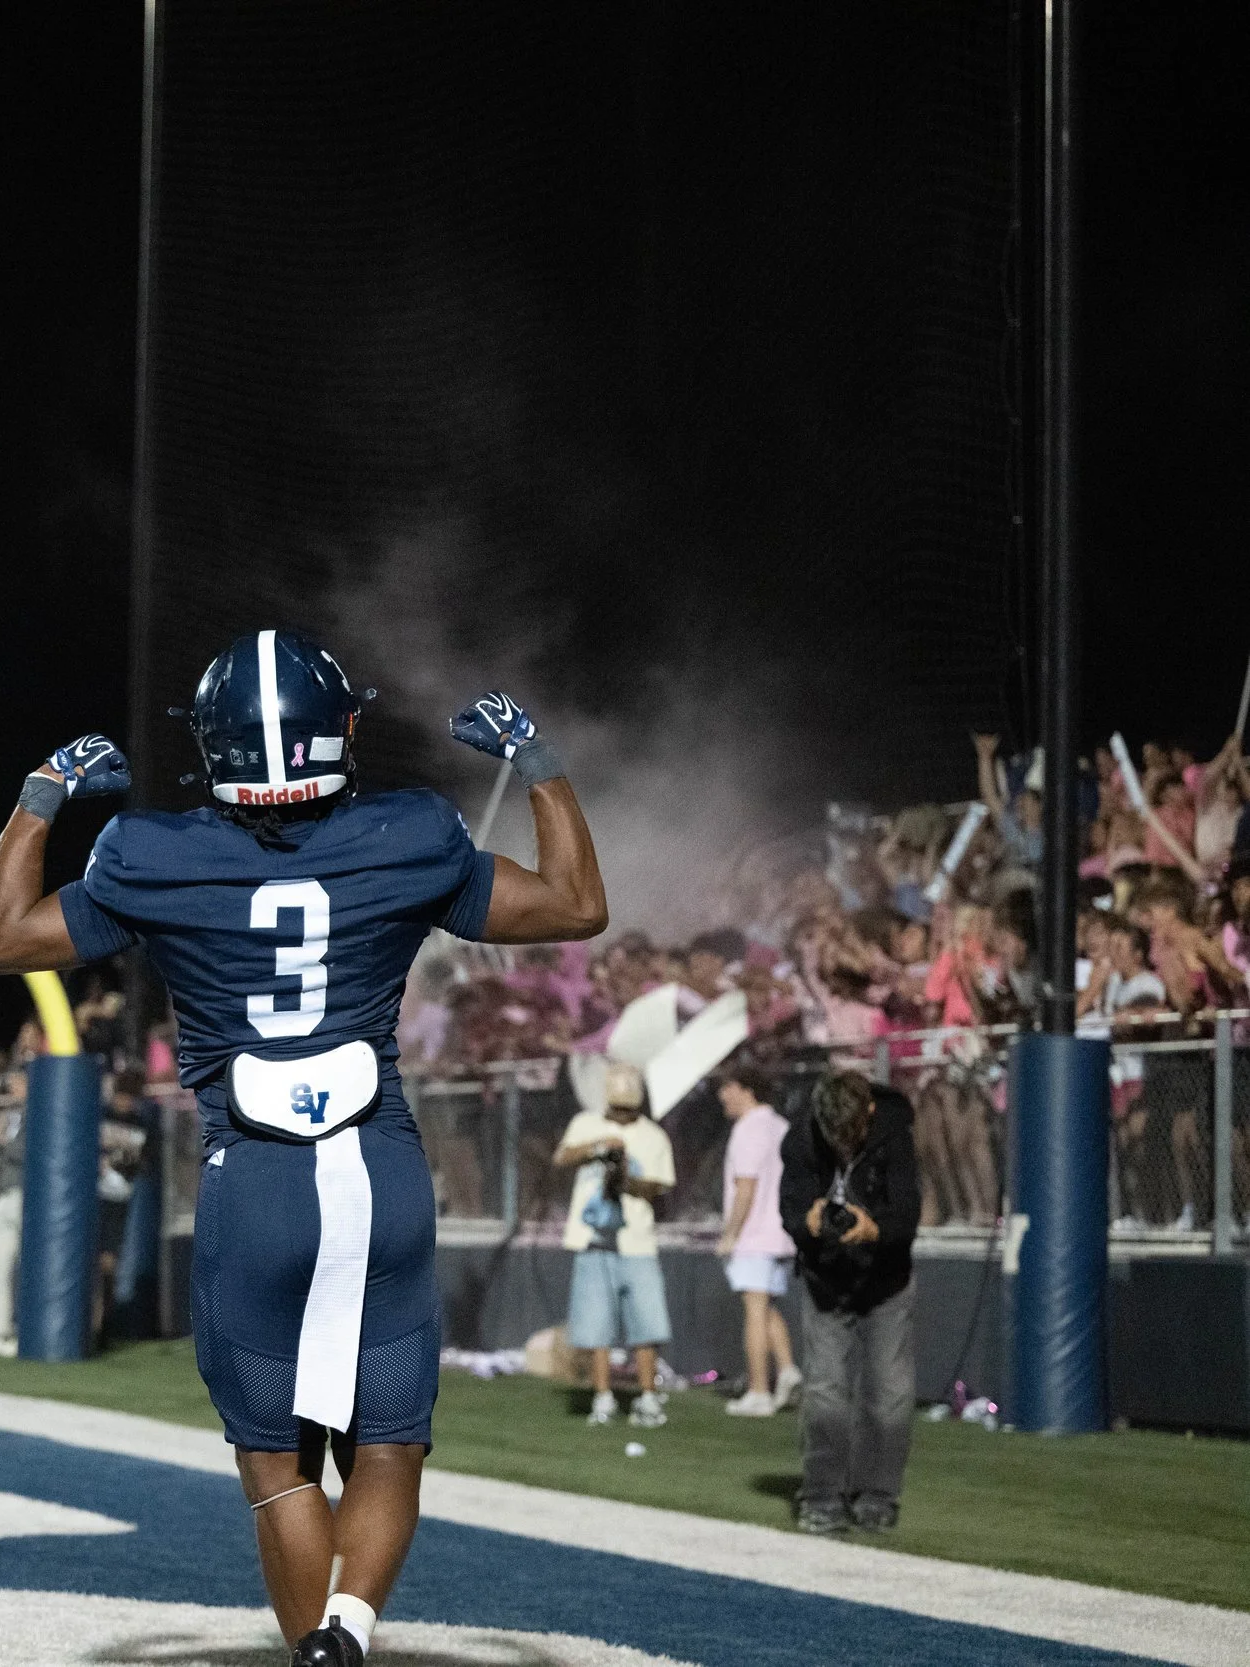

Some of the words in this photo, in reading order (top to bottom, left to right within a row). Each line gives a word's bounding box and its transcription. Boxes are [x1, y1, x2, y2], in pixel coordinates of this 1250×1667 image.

[237, 781, 320, 805] Riddell
[247, 878, 330, 1038] 3
[290, 1083, 330, 1124] SV
